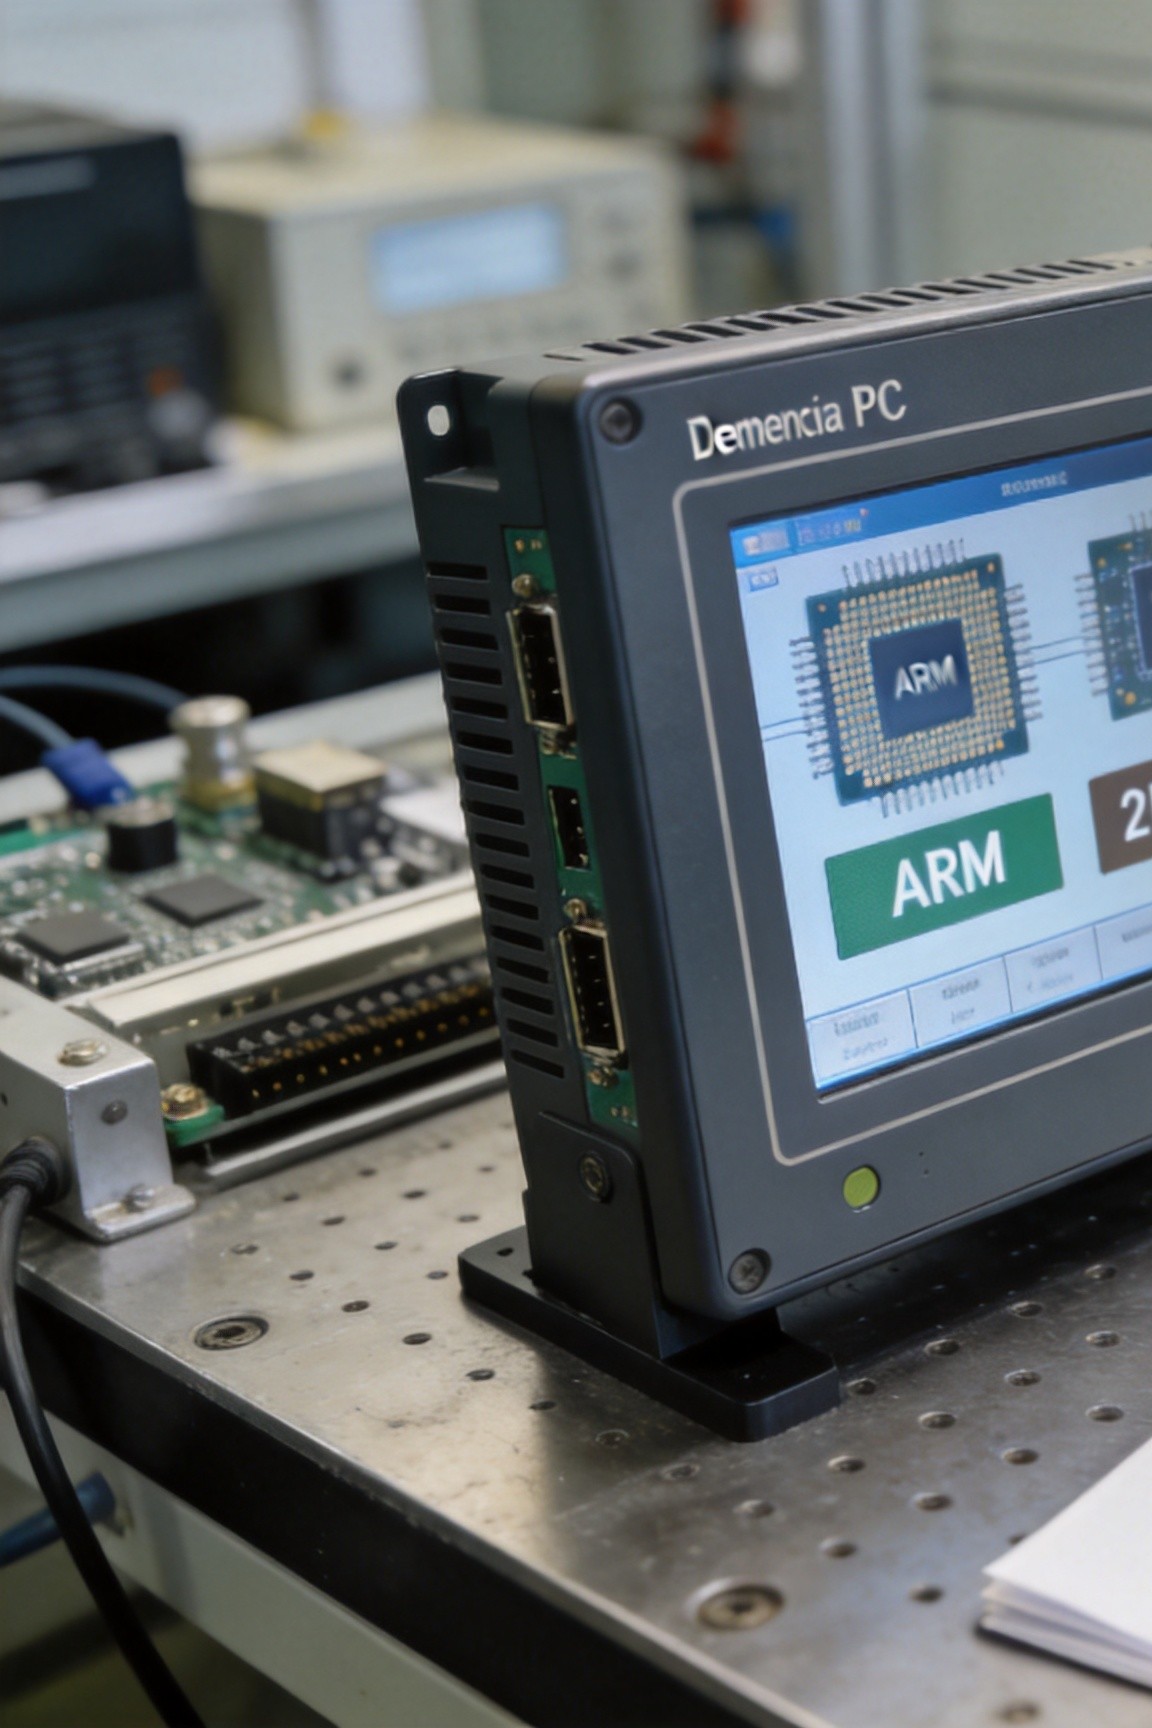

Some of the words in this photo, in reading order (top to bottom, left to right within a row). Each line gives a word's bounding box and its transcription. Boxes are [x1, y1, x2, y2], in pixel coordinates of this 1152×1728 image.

[687, 396, 843, 461] Demencia
[852, 379, 907, 427] PC
[894, 655, 957, 699] ARM
[892, 830, 1006, 918] ARM
